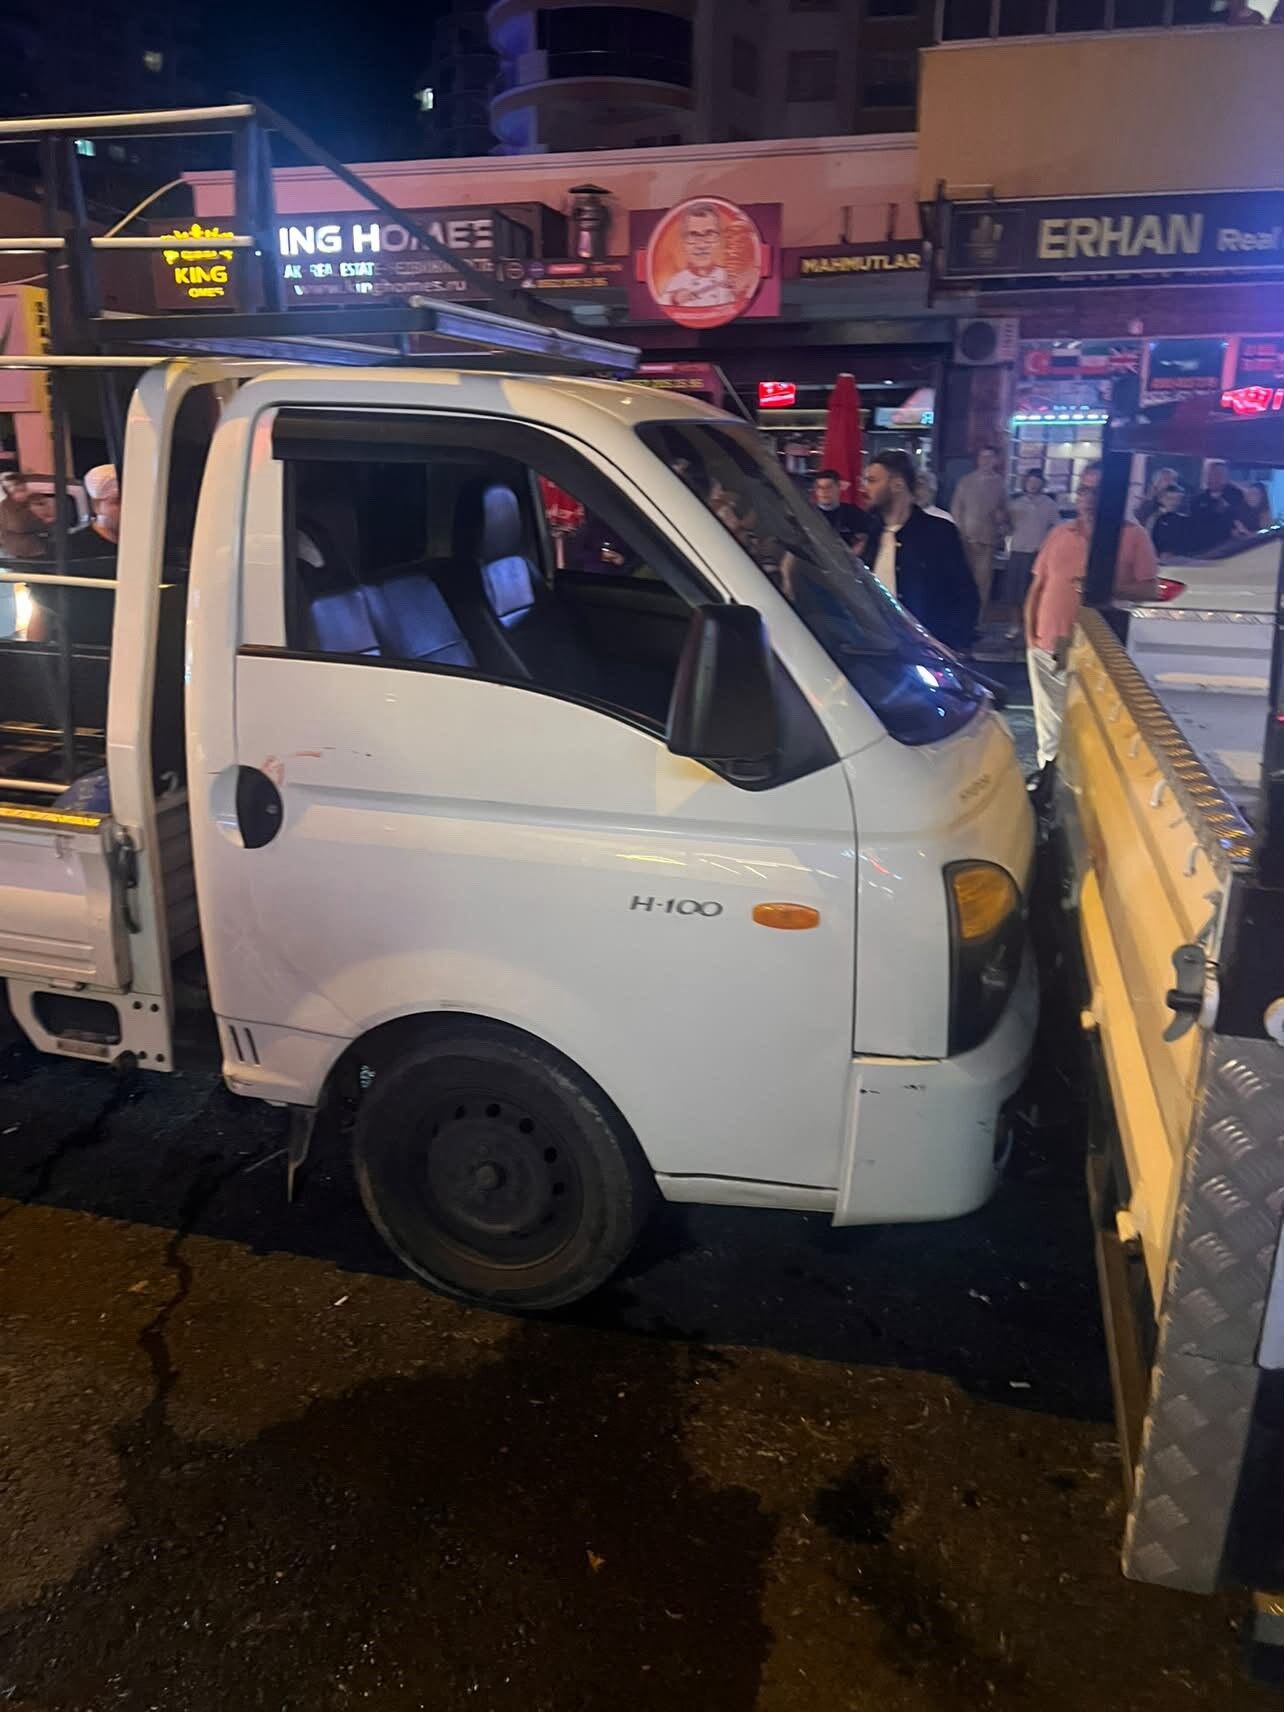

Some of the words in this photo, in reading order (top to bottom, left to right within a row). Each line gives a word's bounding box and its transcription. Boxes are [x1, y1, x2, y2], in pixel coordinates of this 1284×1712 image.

[279, 225, 343, 256] ING
[1038, 212, 1204, 260] ERHAN
[174, 265, 228, 285] KING
[801, 253, 922, 274] MAHMUTLAR
[629, 894, 724, 918] H-100
